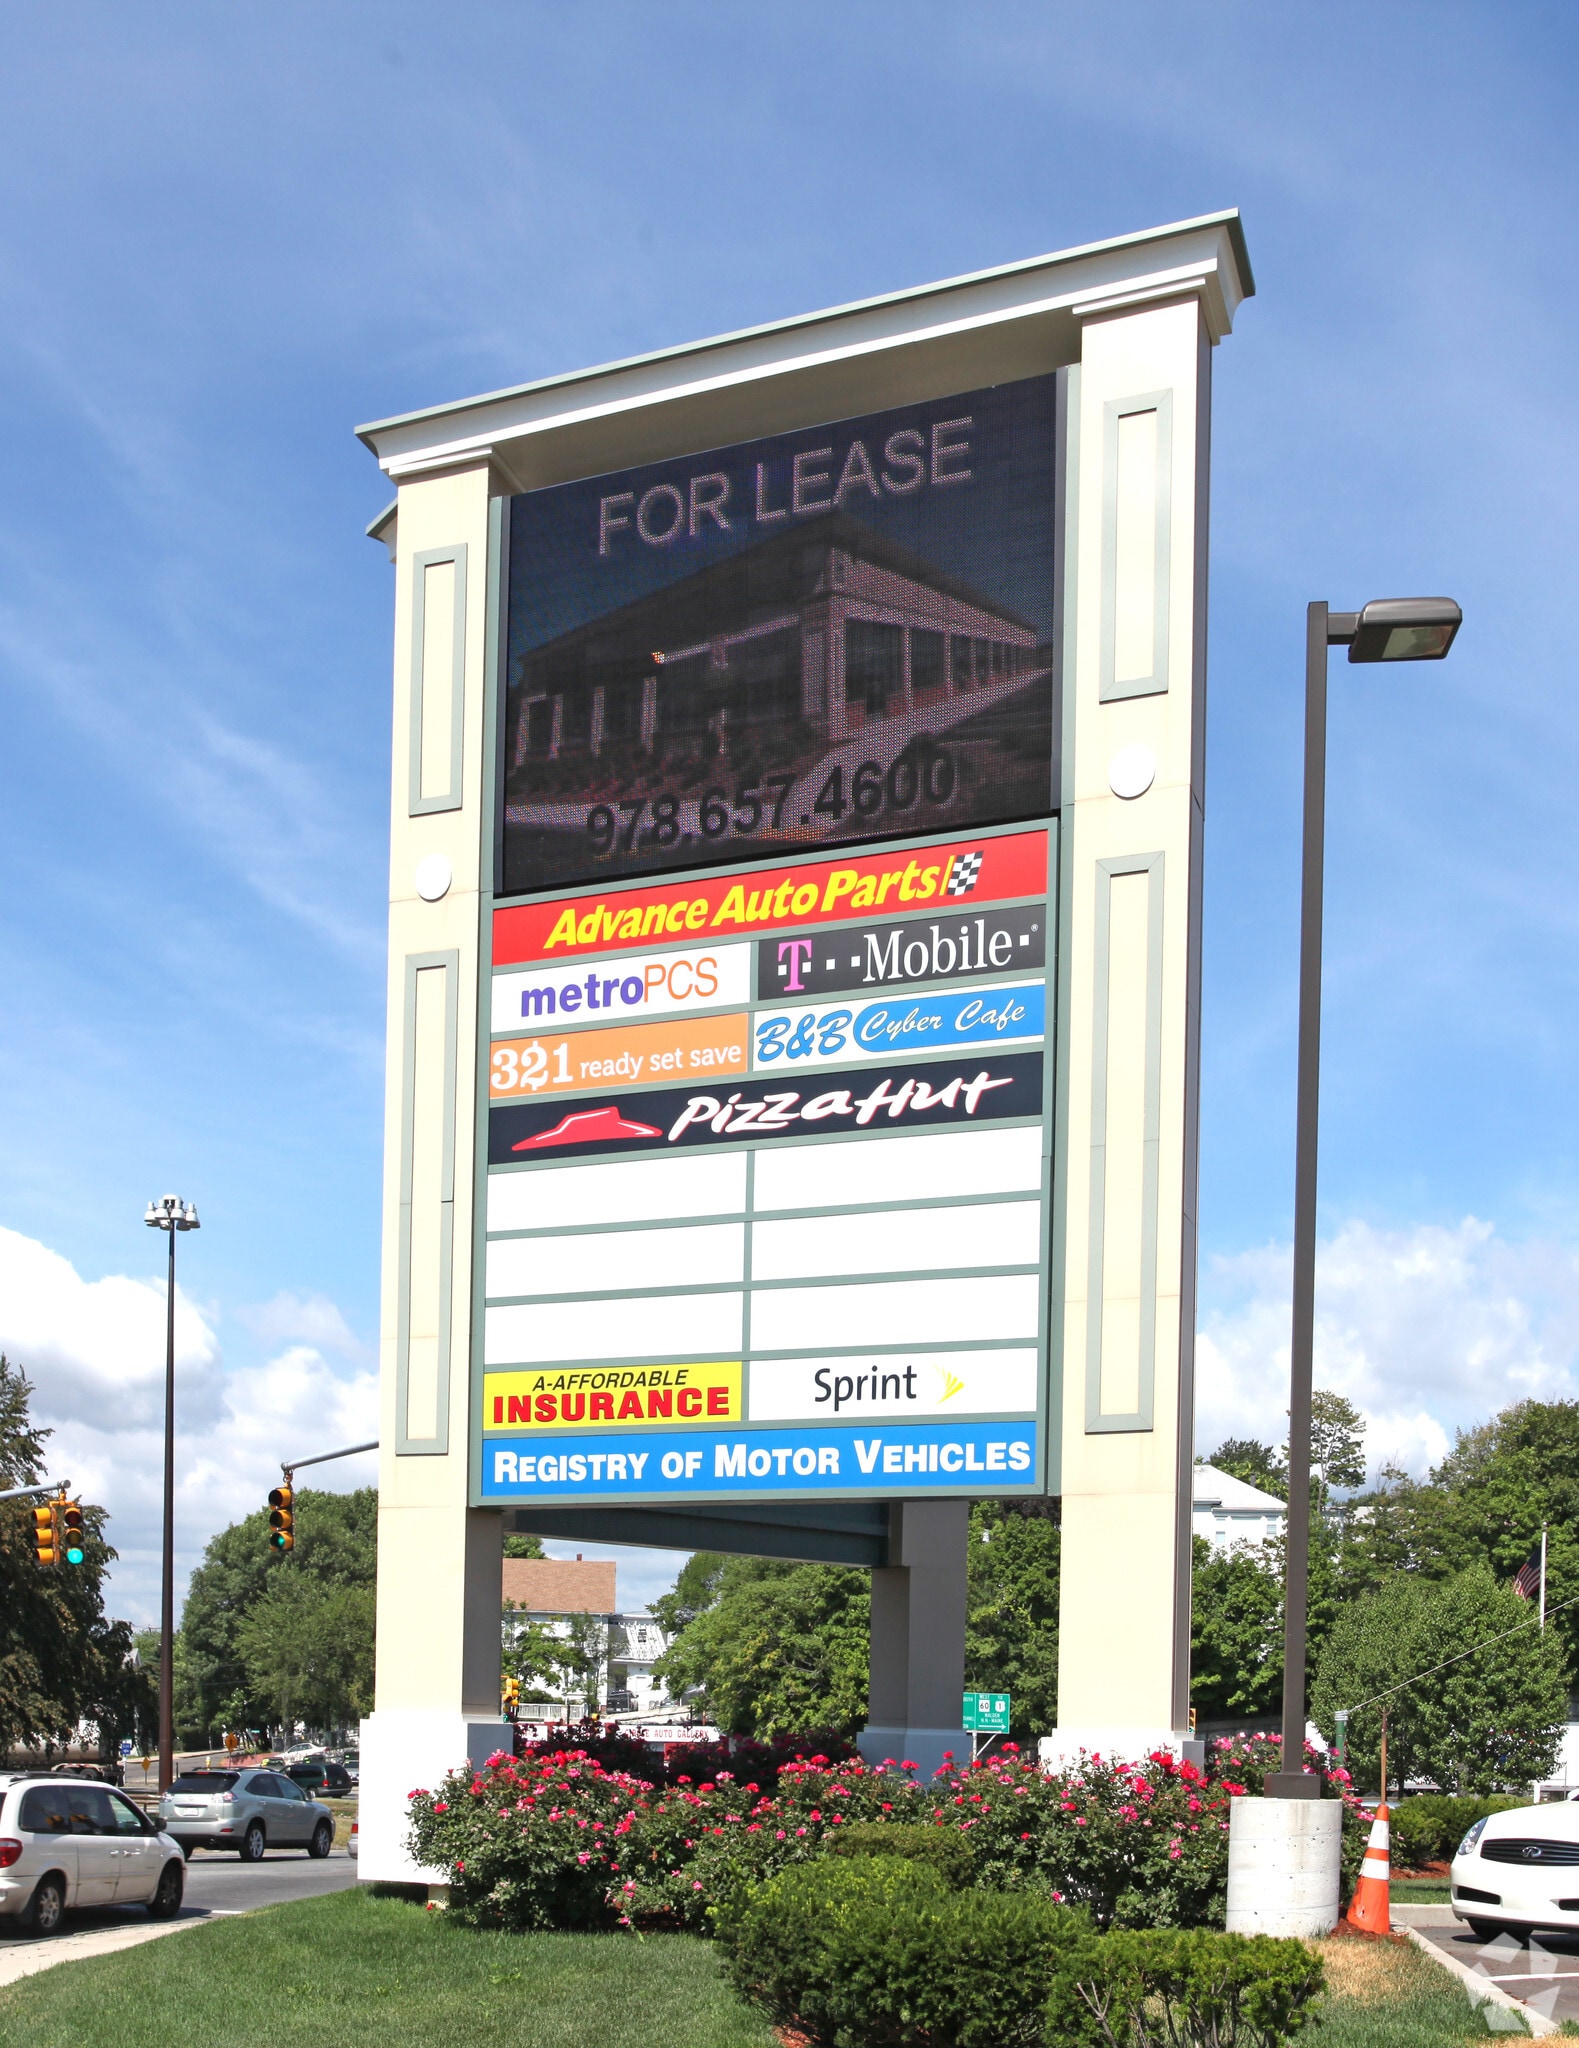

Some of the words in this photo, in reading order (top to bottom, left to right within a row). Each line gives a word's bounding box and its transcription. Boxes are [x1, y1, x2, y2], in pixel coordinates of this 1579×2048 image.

[599, 471, 732, 556] FOR
[755, 416, 973, 522] LEASE
[586, 749, 957, 854] 978.657.4600
[543, 897, 708, 949] Advance
[710, 878, 820, 926] Auto
[820, 860, 941, 911] Parts
[521, 957, 718, 1017] metroPCS
[756, 1009, 852, 1062] B&B
[860, 1008, 943, 1041] Cyber
[954, 999, 1026, 1032] Cafe
[580, 1052, 643, 1079] ready
[650, 1049, 683, 1071] set
[690, 1045, 741, 1067] save
[532, 1369, 689, 1392] A-AFFORDABLE
[814, 1365, 917, 1412] Sprint
[493, 1386, 730, 1424] INSURANCE
[494, 1451, 650, 1484] REGISTRY
[661, 1450, 702, 1478] OF
[714, 1443, 840, 1479] MOTOR
[854, 1440, 1031, 1474] VEHICLES
[654, 1729, 673, 1738] AUTO
[677, 1729, 709, 1738] GALLERY
